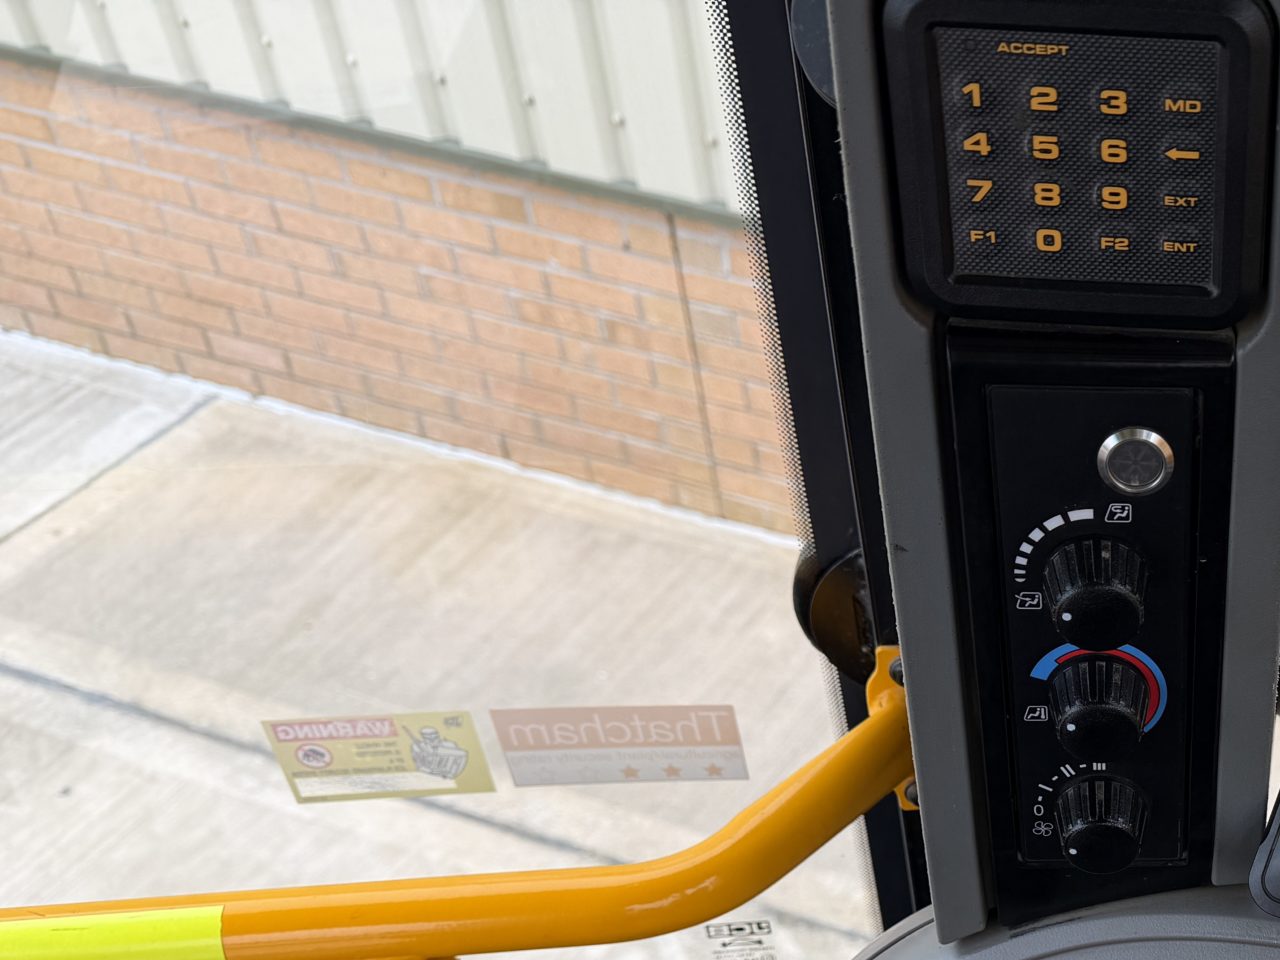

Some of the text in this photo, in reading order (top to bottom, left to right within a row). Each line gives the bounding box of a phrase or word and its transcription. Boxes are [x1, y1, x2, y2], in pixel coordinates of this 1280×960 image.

[997, 42, 1069, 56] ACCEPT
[961, 83, 982, 107] 1
[1030, 86, 1058, 112] 2
[1100, 89, 1128, 115] 3
[1164, 99, 1201, 113] MD
[963, 132, 991, 156] 4
[1032, 135, 1060, 160] 5
[1101, 139, 1128, 163] 6
[966, 179, 993, 203] 7
[1033, 182, 1061, 207] 8
[1101, 186, 1128, 210] 9
[1164, 195, 1198, 208] EXT
[970, 230, 996, 244] F1
[1035, 228, 1062, 252] 0
[1100, 237, 1129, 250] F2
[1163, 241, 1198, 253] ENT
